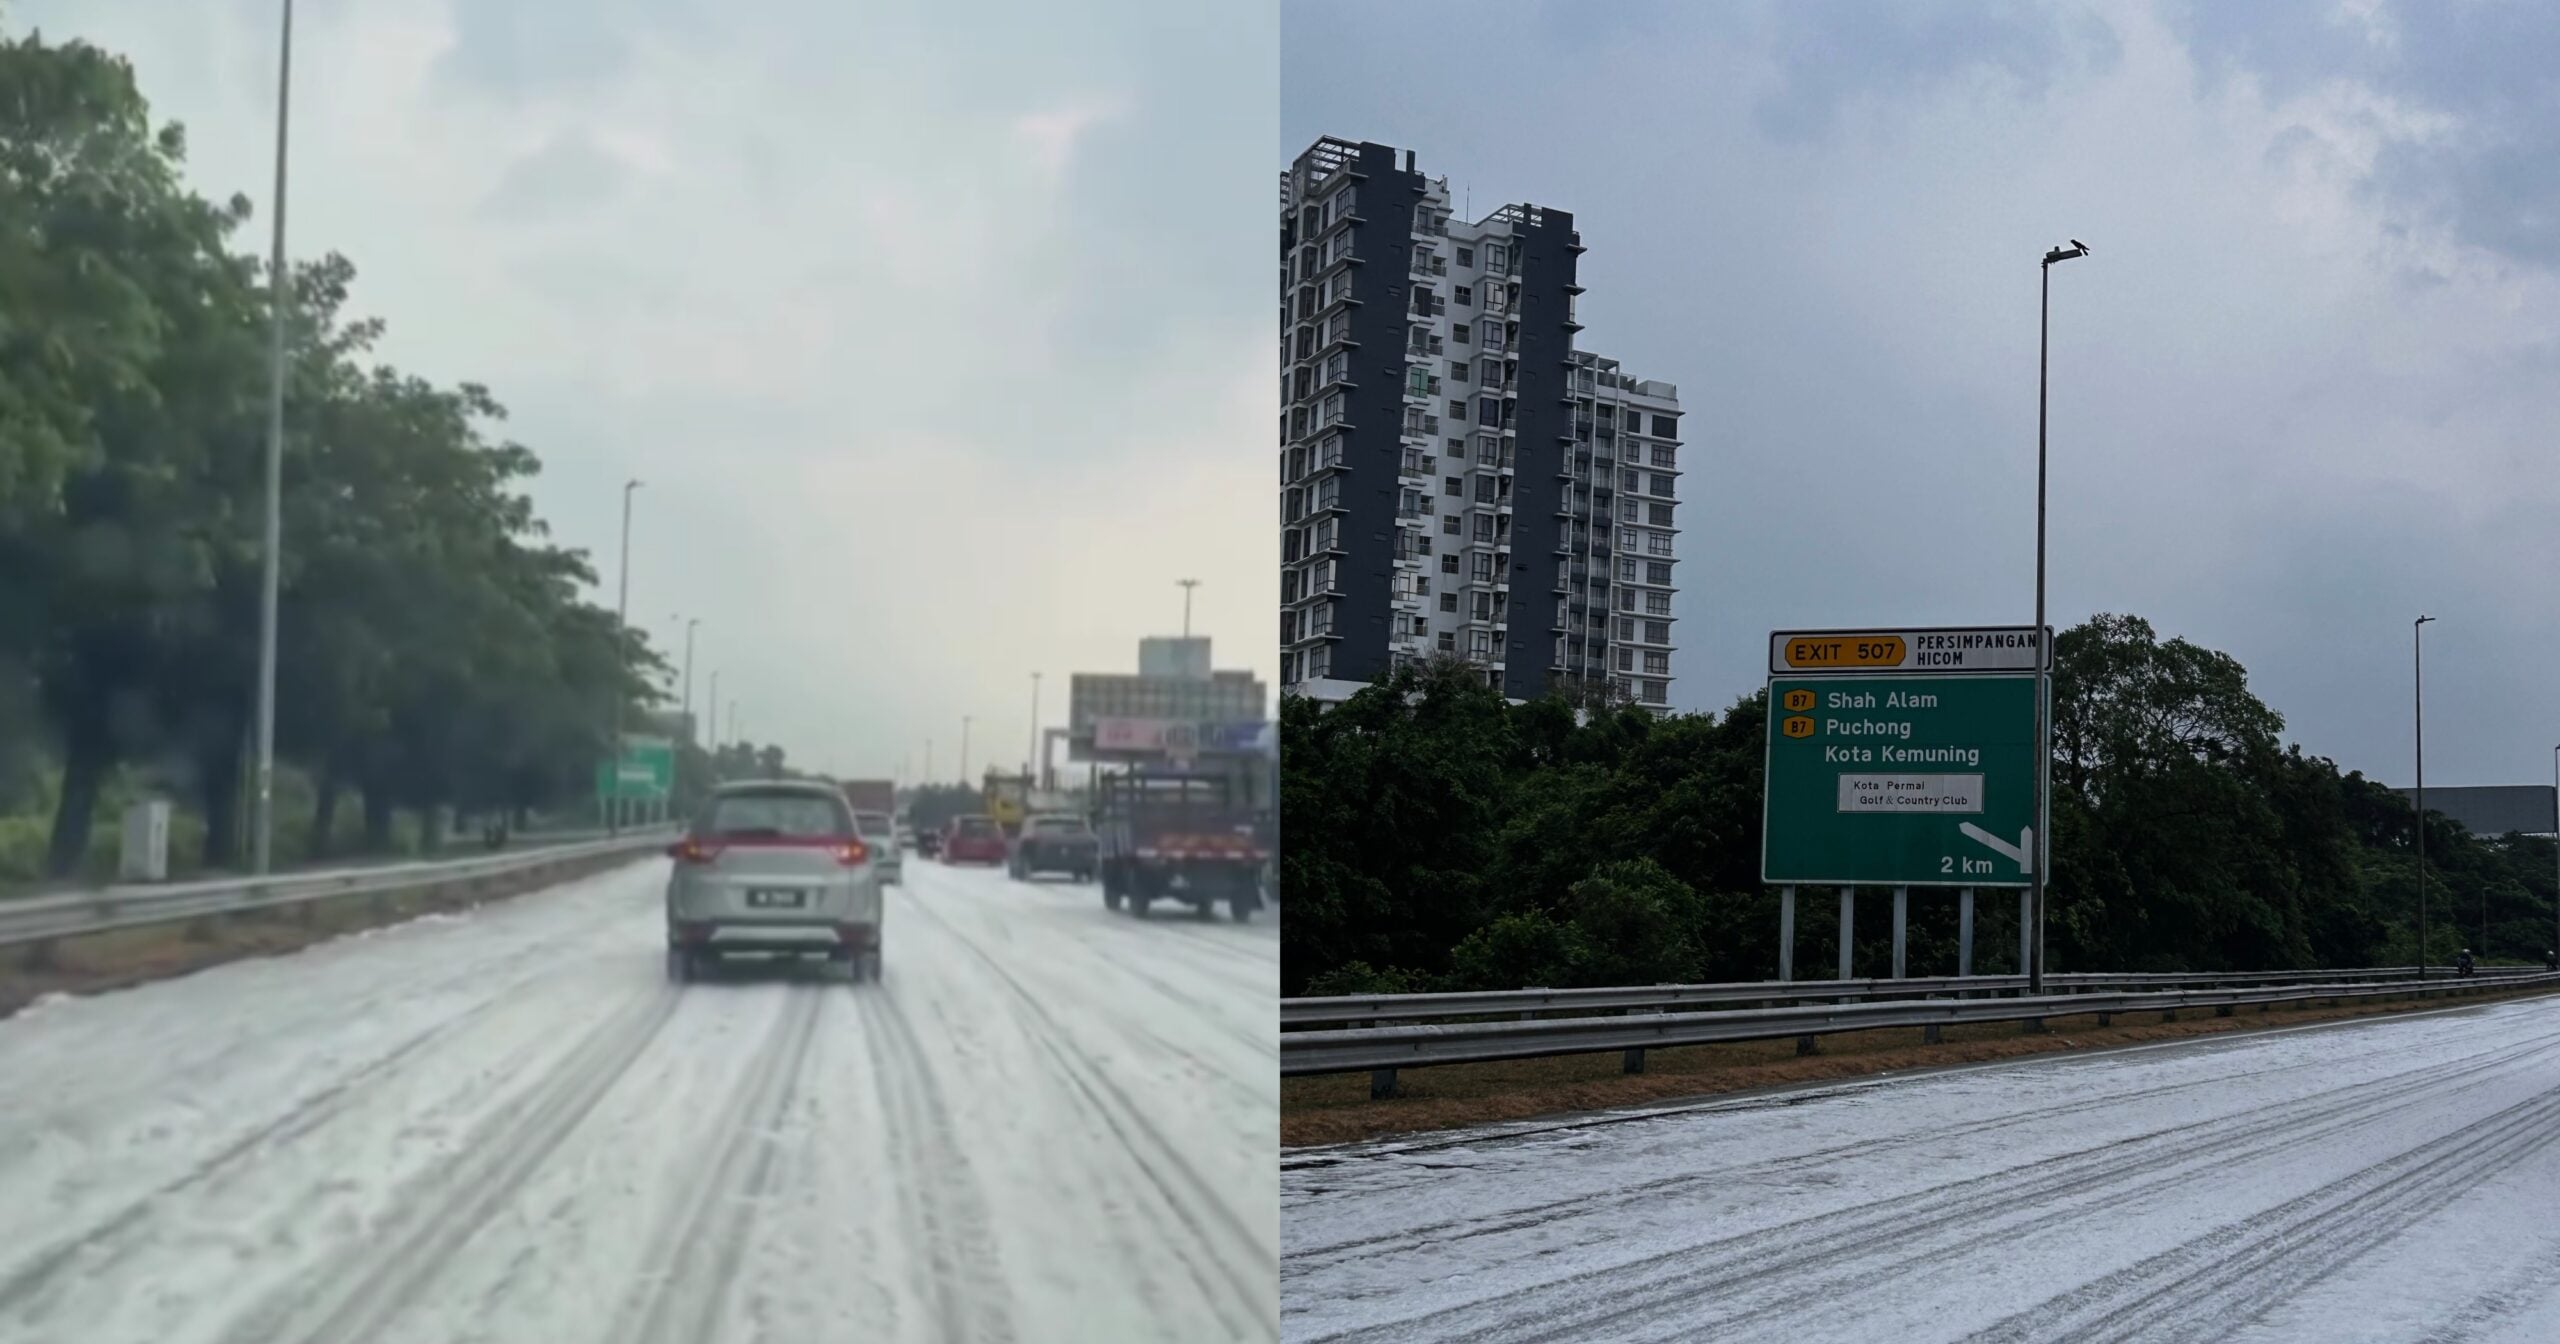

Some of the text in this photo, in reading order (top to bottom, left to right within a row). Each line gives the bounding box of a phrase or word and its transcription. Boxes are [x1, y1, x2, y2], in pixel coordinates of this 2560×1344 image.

[1918, 635, 2036, 649] PERSIMPANGAN
[1796, 643, 1895, 660] EXIT 507
[1918, 651, 1962, 665] HICOM
[1792, 695, 1807, 707] B7
[1828, 692, 1937, 708] Shah Alam
[1792, 721, 1806, 733] B7
[1827, 719, 1911, 739] Puchong
[1826, 745, 1979, 765] Kota Kemuning
[1854, 781, 1879, 790] Kota
[1860, 796, 1967, 806] Golf & Country Club
[1941, 856, 1992, 873] 2 km
